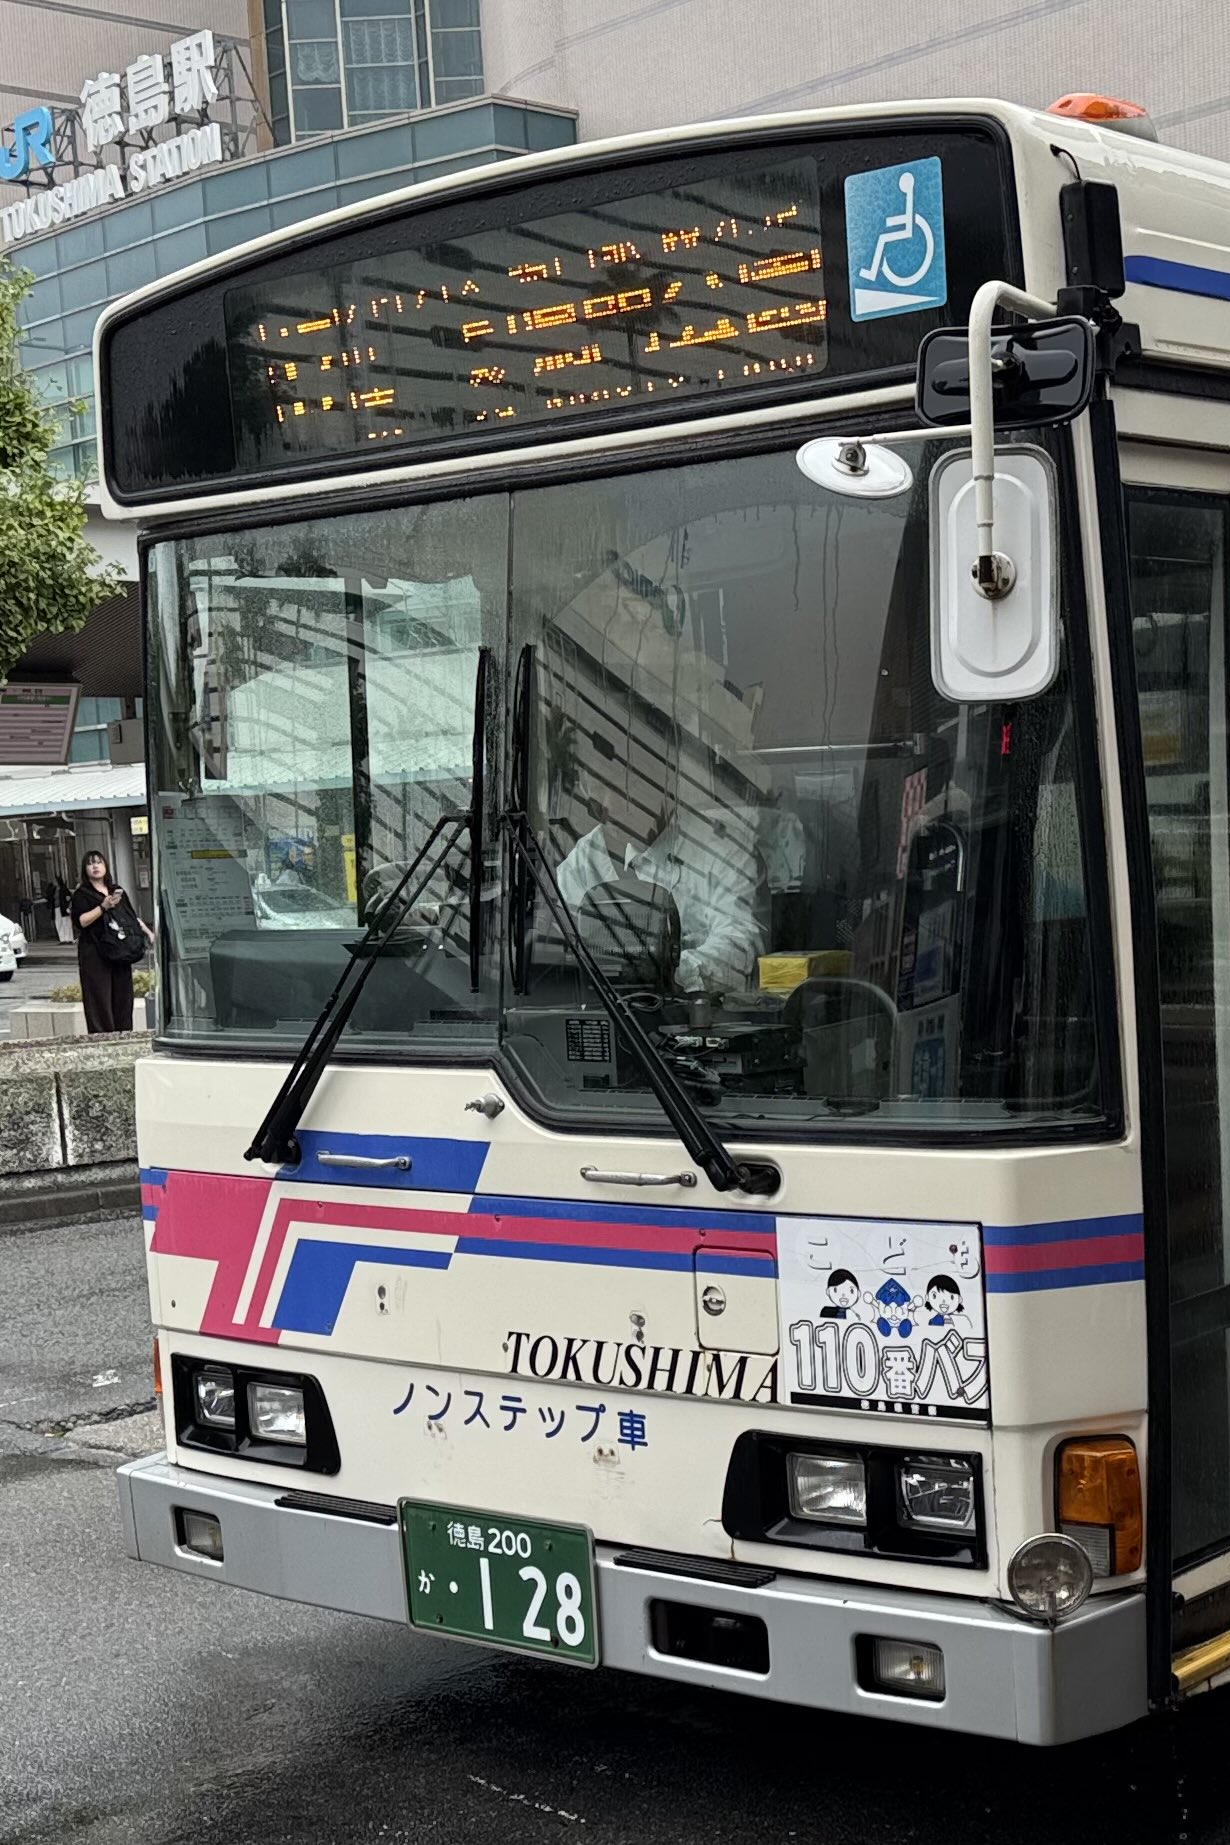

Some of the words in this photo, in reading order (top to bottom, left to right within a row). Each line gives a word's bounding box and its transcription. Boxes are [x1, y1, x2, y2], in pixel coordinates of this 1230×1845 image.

[0, 106, 56, 180] JR
[79, 28, 218, 152] 徳島駅
[1, 163, 125, 242] TOKUSHIMA
[129, 122, 222, 192] STATION
[507, 1331, 780, 1404] TOKUSHIMA
[393, 1381, 648, 1452] ノンステップ車
